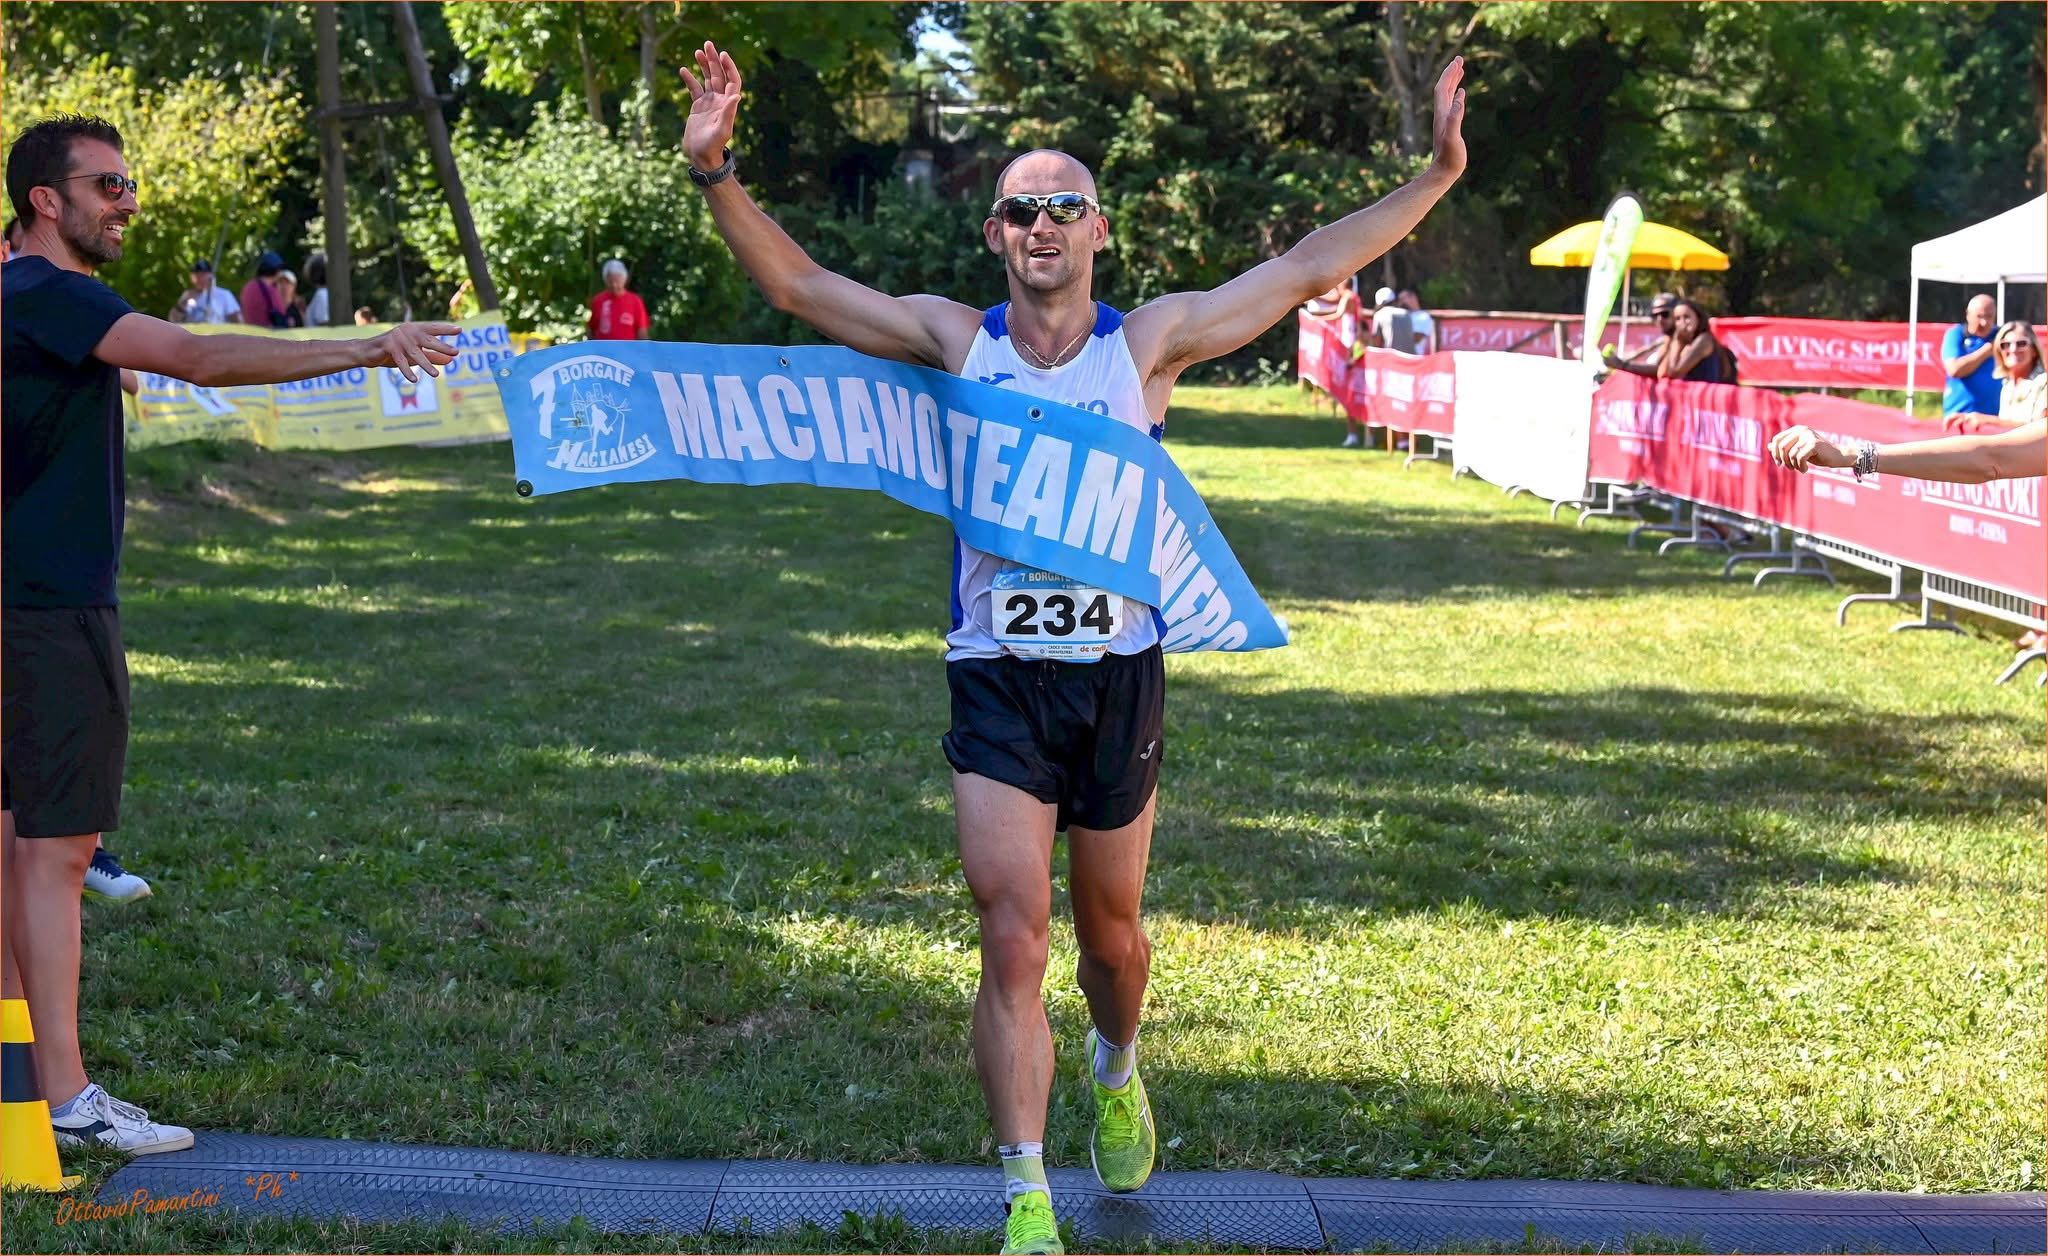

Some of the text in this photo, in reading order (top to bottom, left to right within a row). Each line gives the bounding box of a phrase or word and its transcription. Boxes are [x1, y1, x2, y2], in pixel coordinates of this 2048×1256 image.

[1755, 335, 1844, 360] LIVING
[558, 361, 633, 388] BORGATE
[547, 433, 656, 472] MACIANESI
[652, 370, 947, 490] MACIANO
[946, 407, 1145, 564] TEAM
[1021, 573, 1026, 583] 7
[1005, 594, 1114, 637] 234
